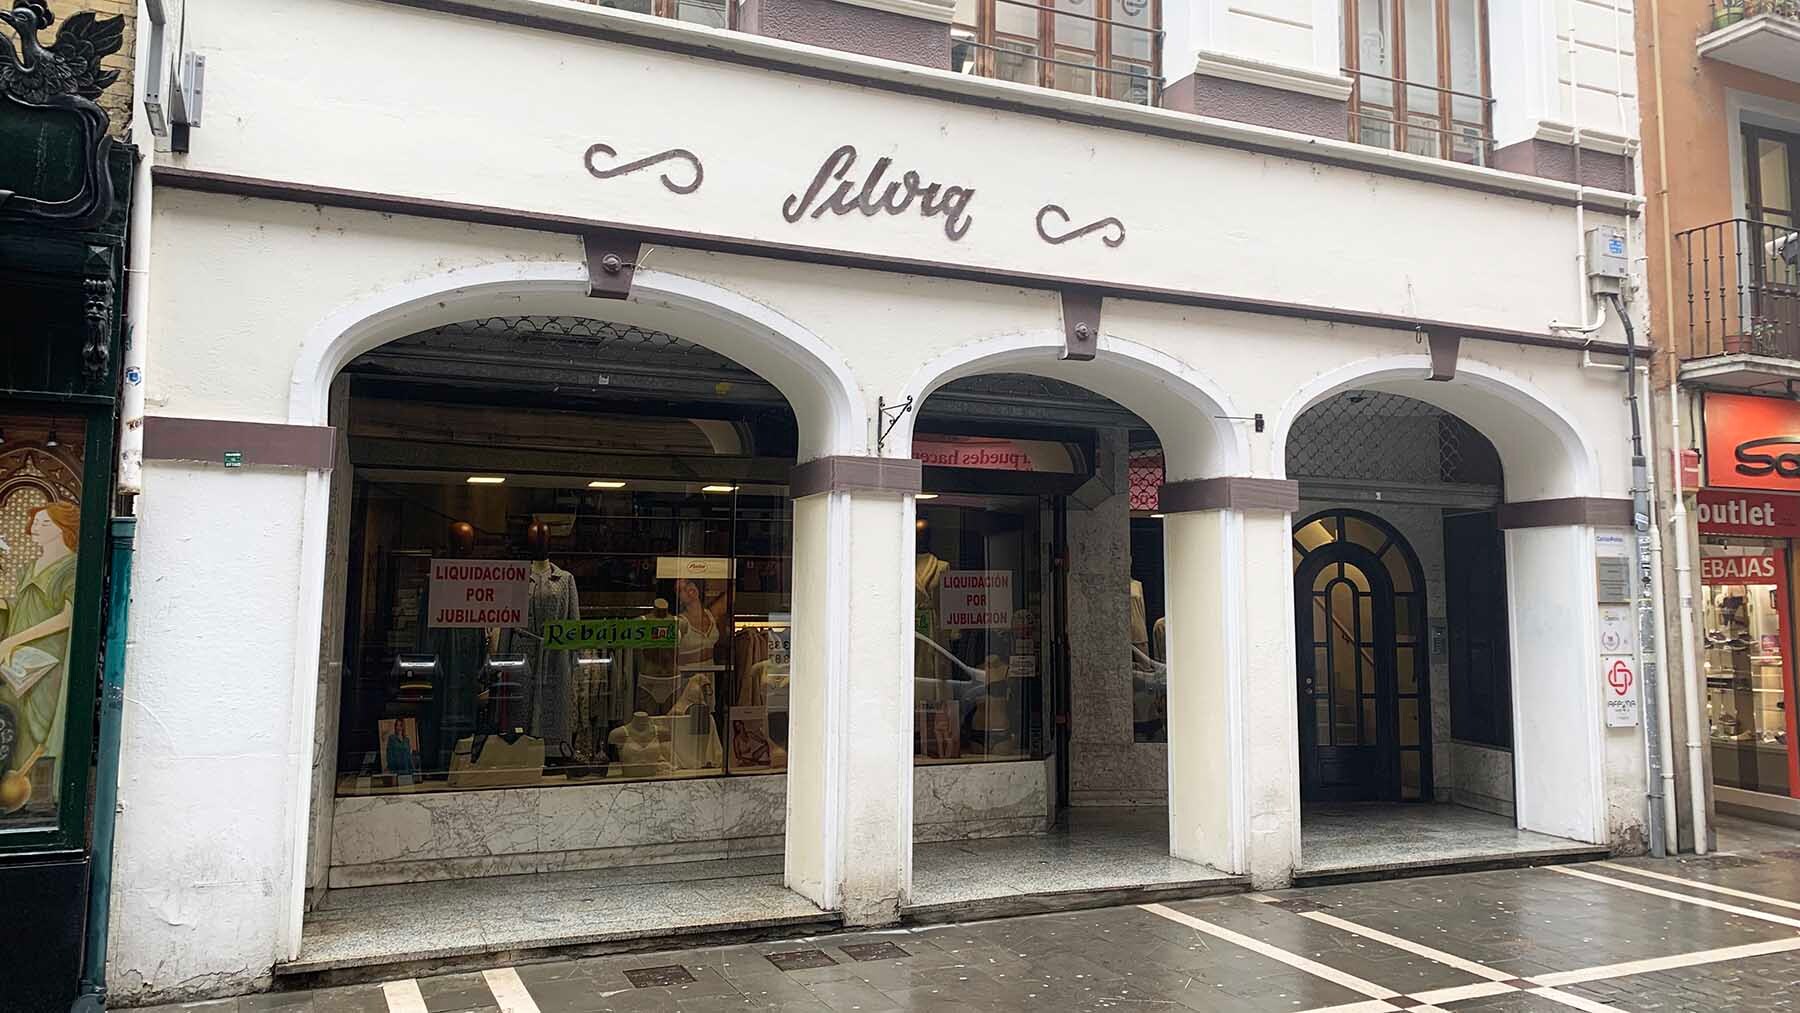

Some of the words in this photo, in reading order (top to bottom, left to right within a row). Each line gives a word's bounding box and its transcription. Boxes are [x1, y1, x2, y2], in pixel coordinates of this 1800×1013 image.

[1697, 499, 1775, 527] outlet
[435, 564, 526, 580] LIQUIDACIÓN
[1701, 556, 1775, 579] EBAJAS
[466, 588, 494, 601] POR
[966, 594, 988, 606] POR
[436, 606, 521, 623] JUBILACIÓN
[549, 624, 646, 645] Rebajas
